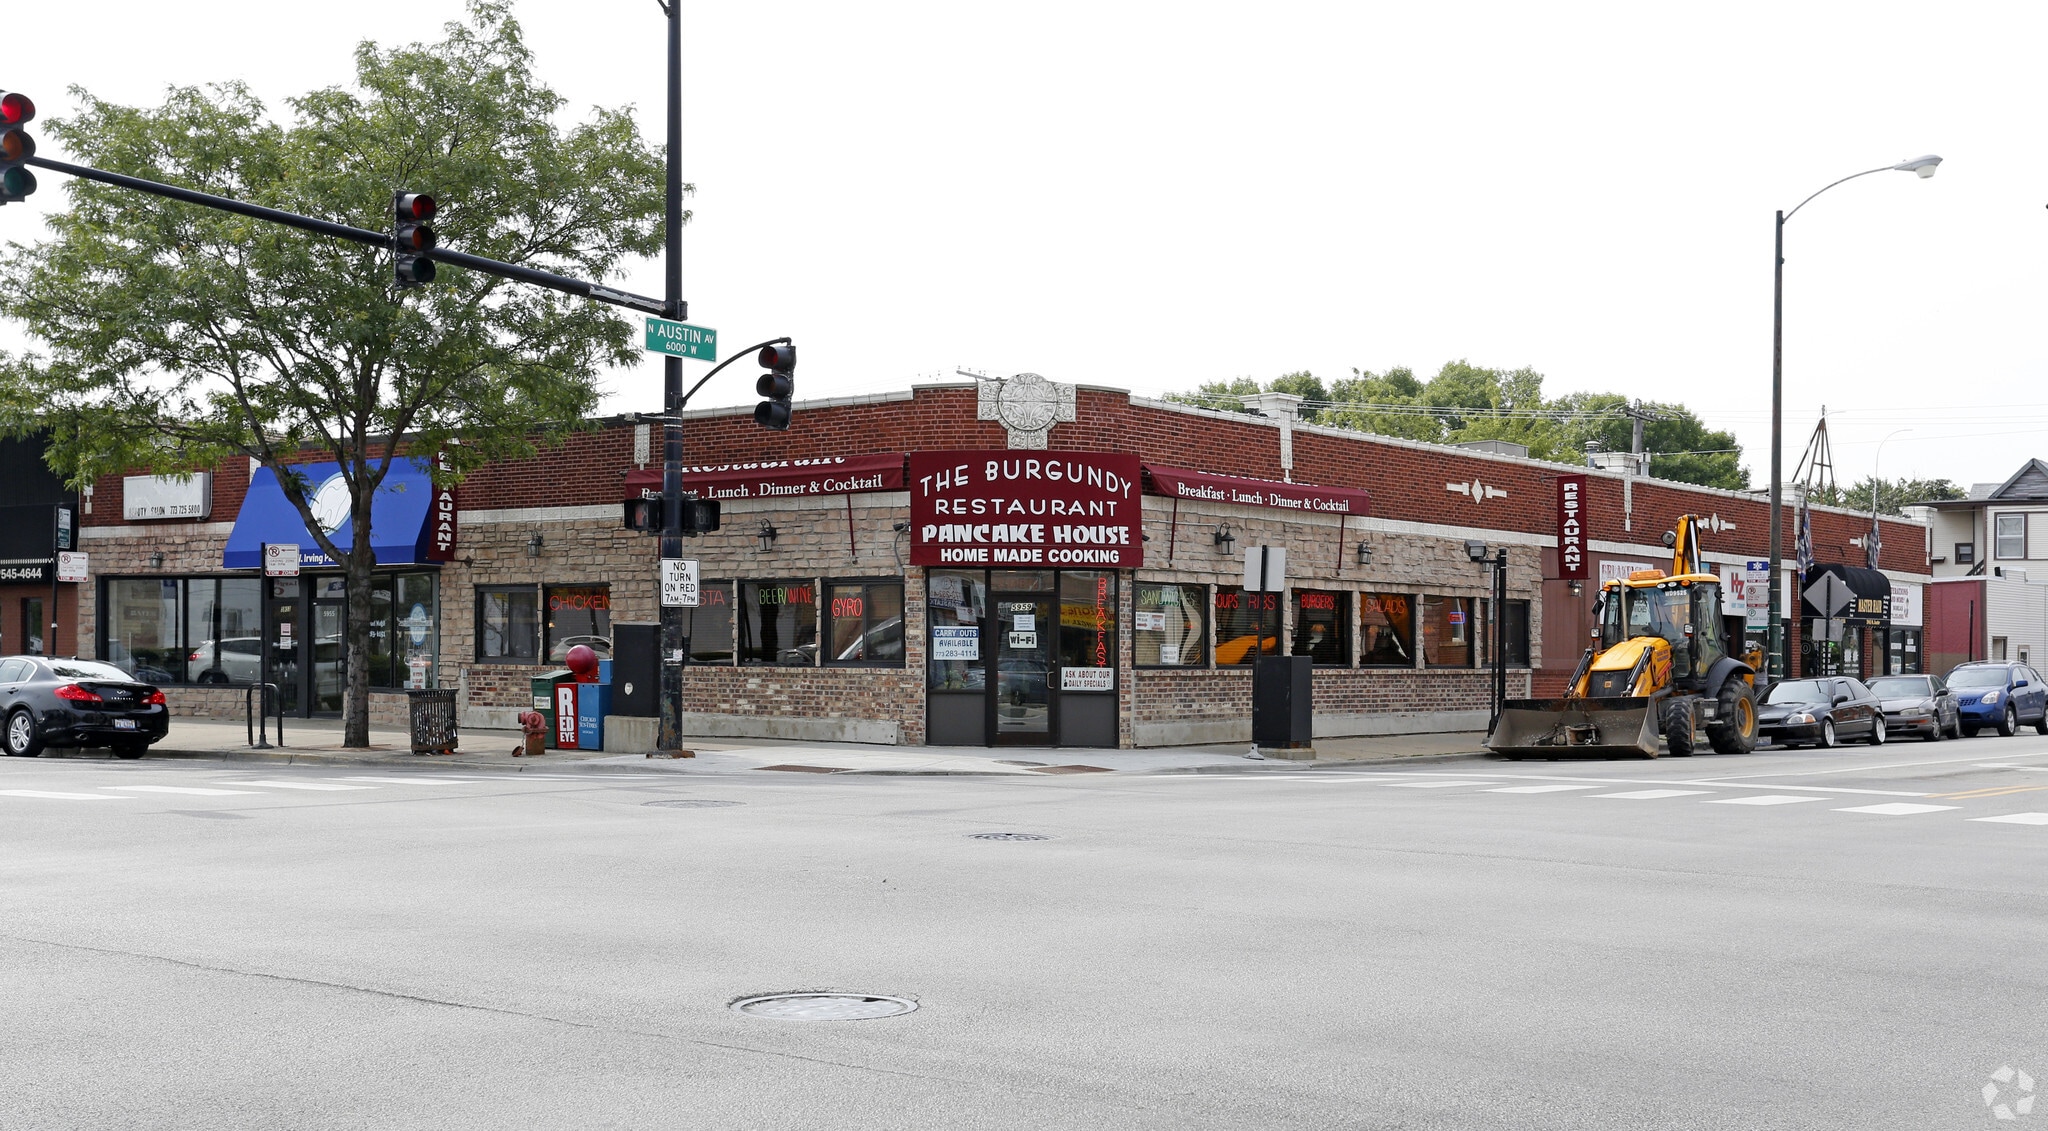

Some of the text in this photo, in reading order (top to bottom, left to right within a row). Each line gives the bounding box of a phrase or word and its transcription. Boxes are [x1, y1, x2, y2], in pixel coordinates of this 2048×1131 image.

[648, 323, 714, 344] N AUSTIN AV
[665, 341, 698, 355] 6000 W
[708, 484, 749, 499] Lunch
[759, 482, 806, 496] Dinner
[809, 481, 820, 493] &
[823, 474, 883, 492] Cocktail
[920, 459, 1132, 499] THE BURGUNDY
[1177, 482, 1349, 512] Breakfast Lunch Dinner & Cocktail
[935, 499, 1118, 516] RESTAURANT
[922, 524, 1129, 544] PANCAKE HOUSE
[1563, 483, 1580, 571] RESTAURANT
[304, 553, 323, 564] Irving
[941, 548, 1120, 563] HOME MADE COOKING
[673, 562, 686, 571] NO
[669, 573, 691, 581] TURN
[664, 583, 696, 592] ON RED
[759, 585, 813, 605] BEER/WINE
[550, 595, 611, 611] CHICKEN
[832, 598, 863, 617] GYRO
[1216, 593, 1239, 609] OUPS
[1301, 594, 1334, 610] BURGERS
[1365, 599, 1406, 614] SALADS
[1095, 577, 1107, 668] BREAKFAST
[1099, 671, 1110, 679] OUR
[1084, 680, 1107, 688] SPECIALS
[560, 731, 575, 742] EYE
